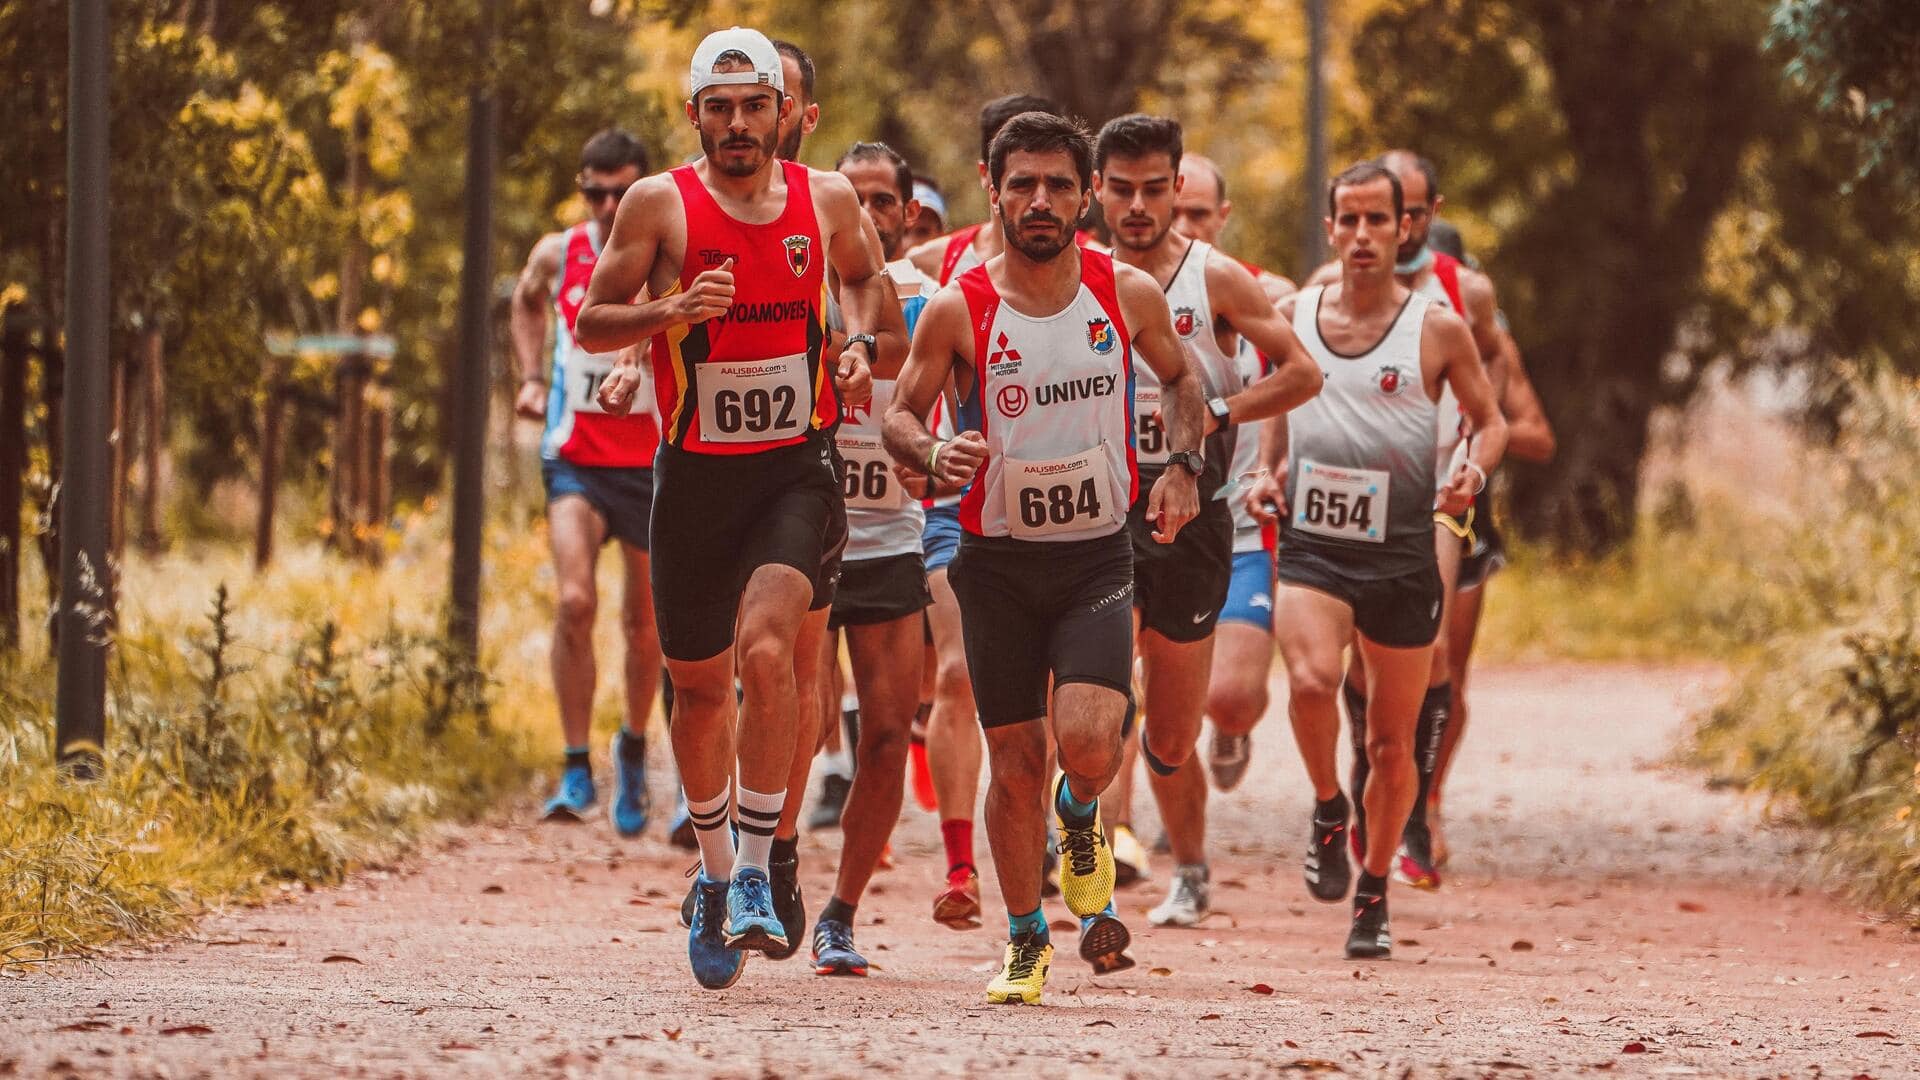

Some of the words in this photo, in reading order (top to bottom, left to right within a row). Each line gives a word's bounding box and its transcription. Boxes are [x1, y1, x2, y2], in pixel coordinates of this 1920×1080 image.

[720, 360, 781, 375] AALISBOA.com
[991, 361, 1022, 371] MITSUBISHI
[996, 368, 1019, 376] MOTORS
[1035, 374, 1117, 406] UNIVEX
[715, 385, 797, 433] 692
[1024, 460, 1083, 473] AALISBOA.com
[1019, 477, 1101, 528] 684
[1306, 488, 1372, 532] 654
